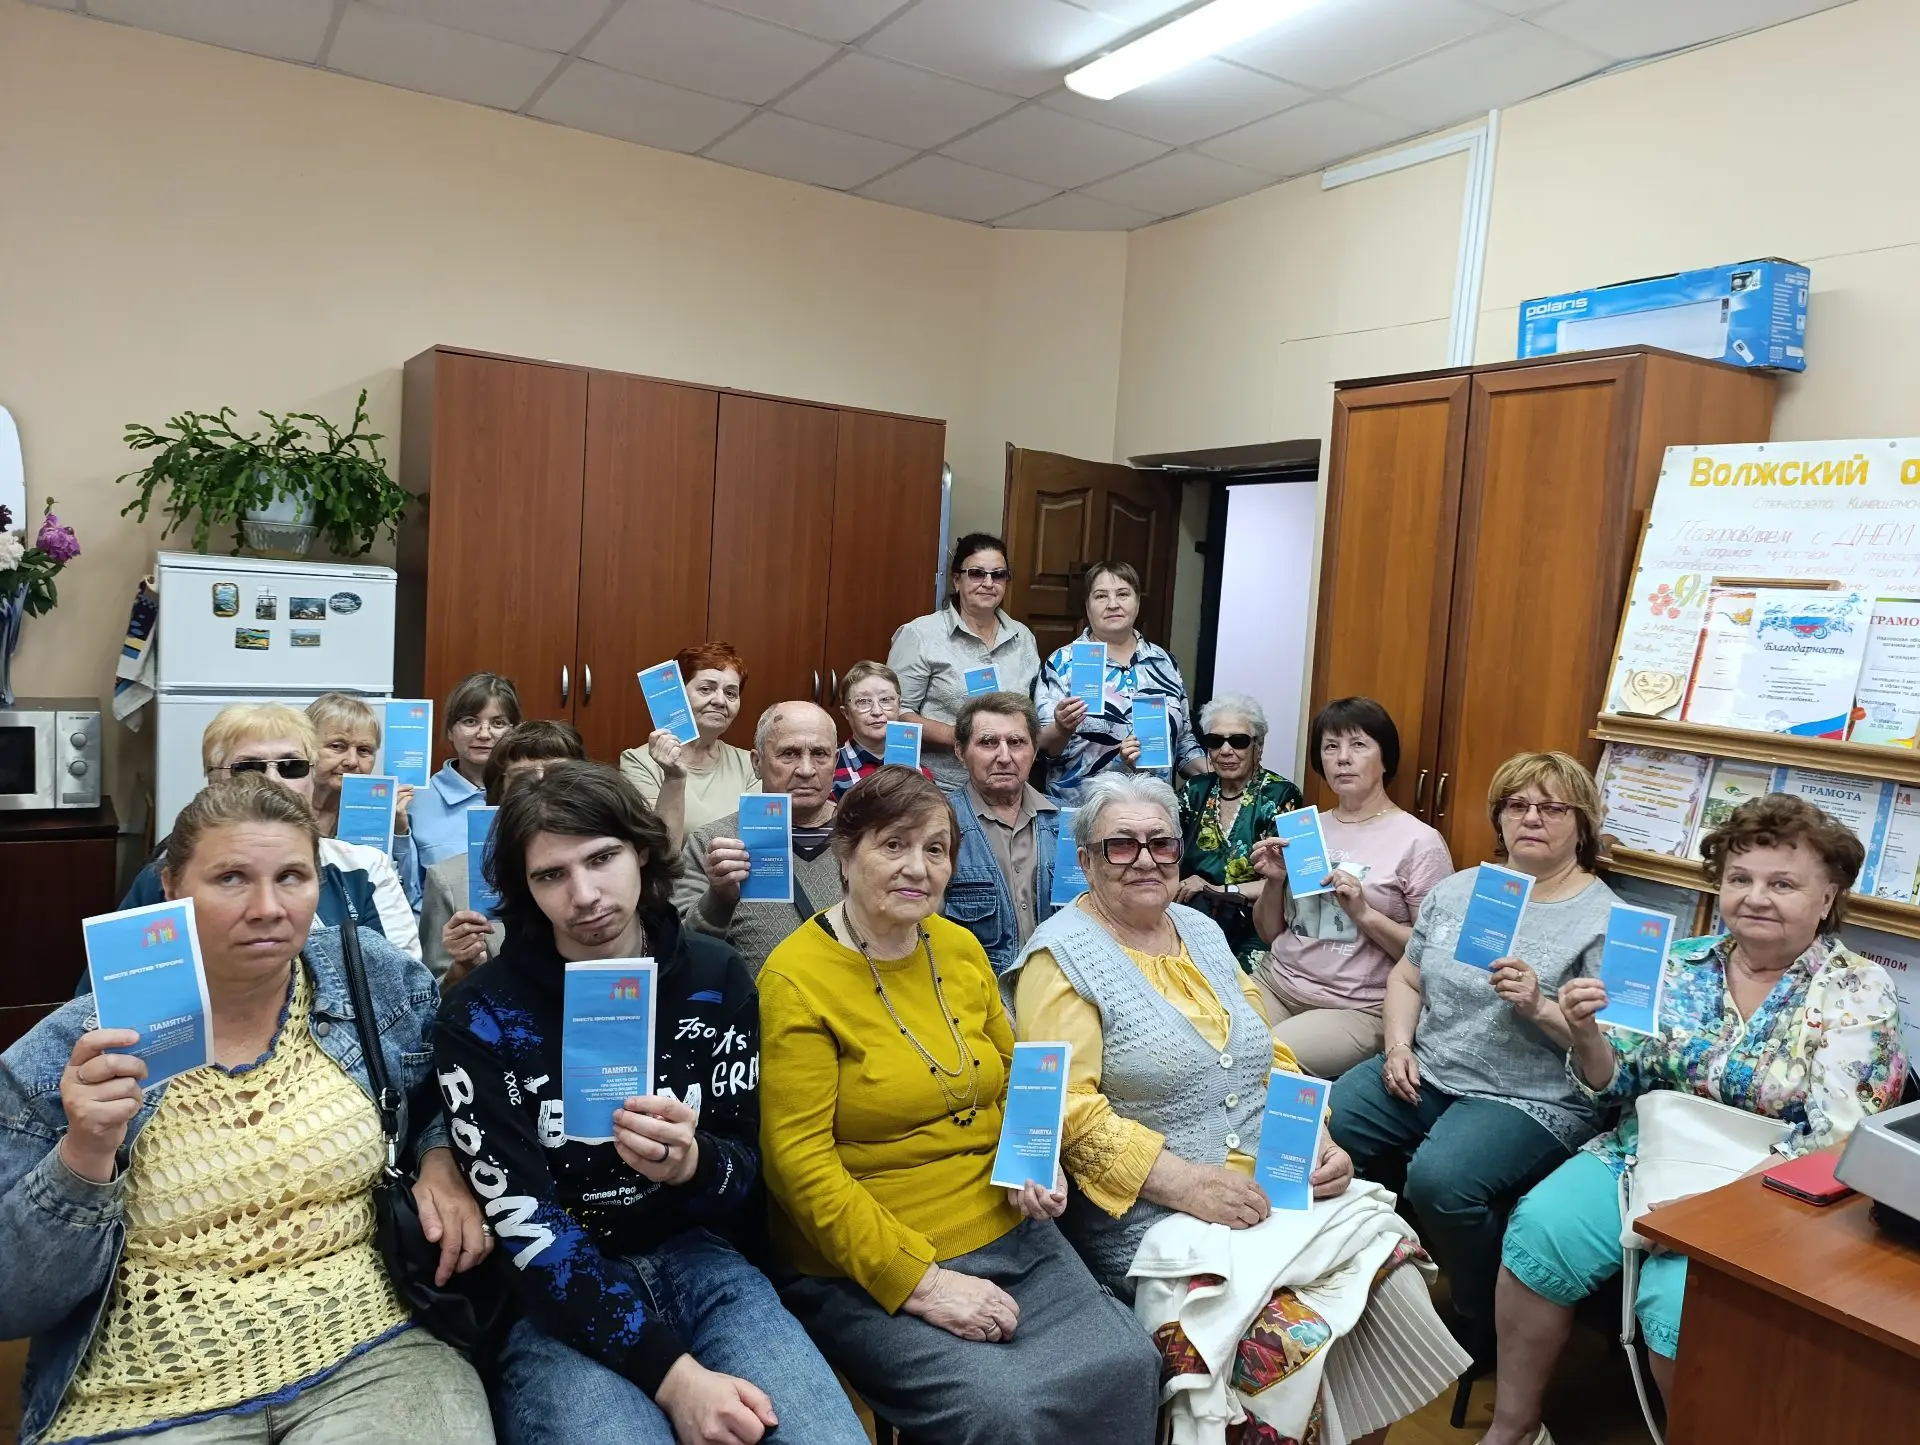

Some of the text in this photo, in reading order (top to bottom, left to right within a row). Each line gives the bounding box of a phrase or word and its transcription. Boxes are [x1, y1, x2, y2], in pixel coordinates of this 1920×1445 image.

[1526, 298, 1588, 320] polaris
[1689, 453, 1869, 486] Волжский
[1764, 641, 1845, 656] Благодарность
[1800, 784, 1862, 802] ГРАМОТА
[149, 1014, 193, 1032] ПАМЯТКА
[601, 1065, 638, 1075] ПАМЯТКА
[503, 1070, 522, 1106] 20XX
